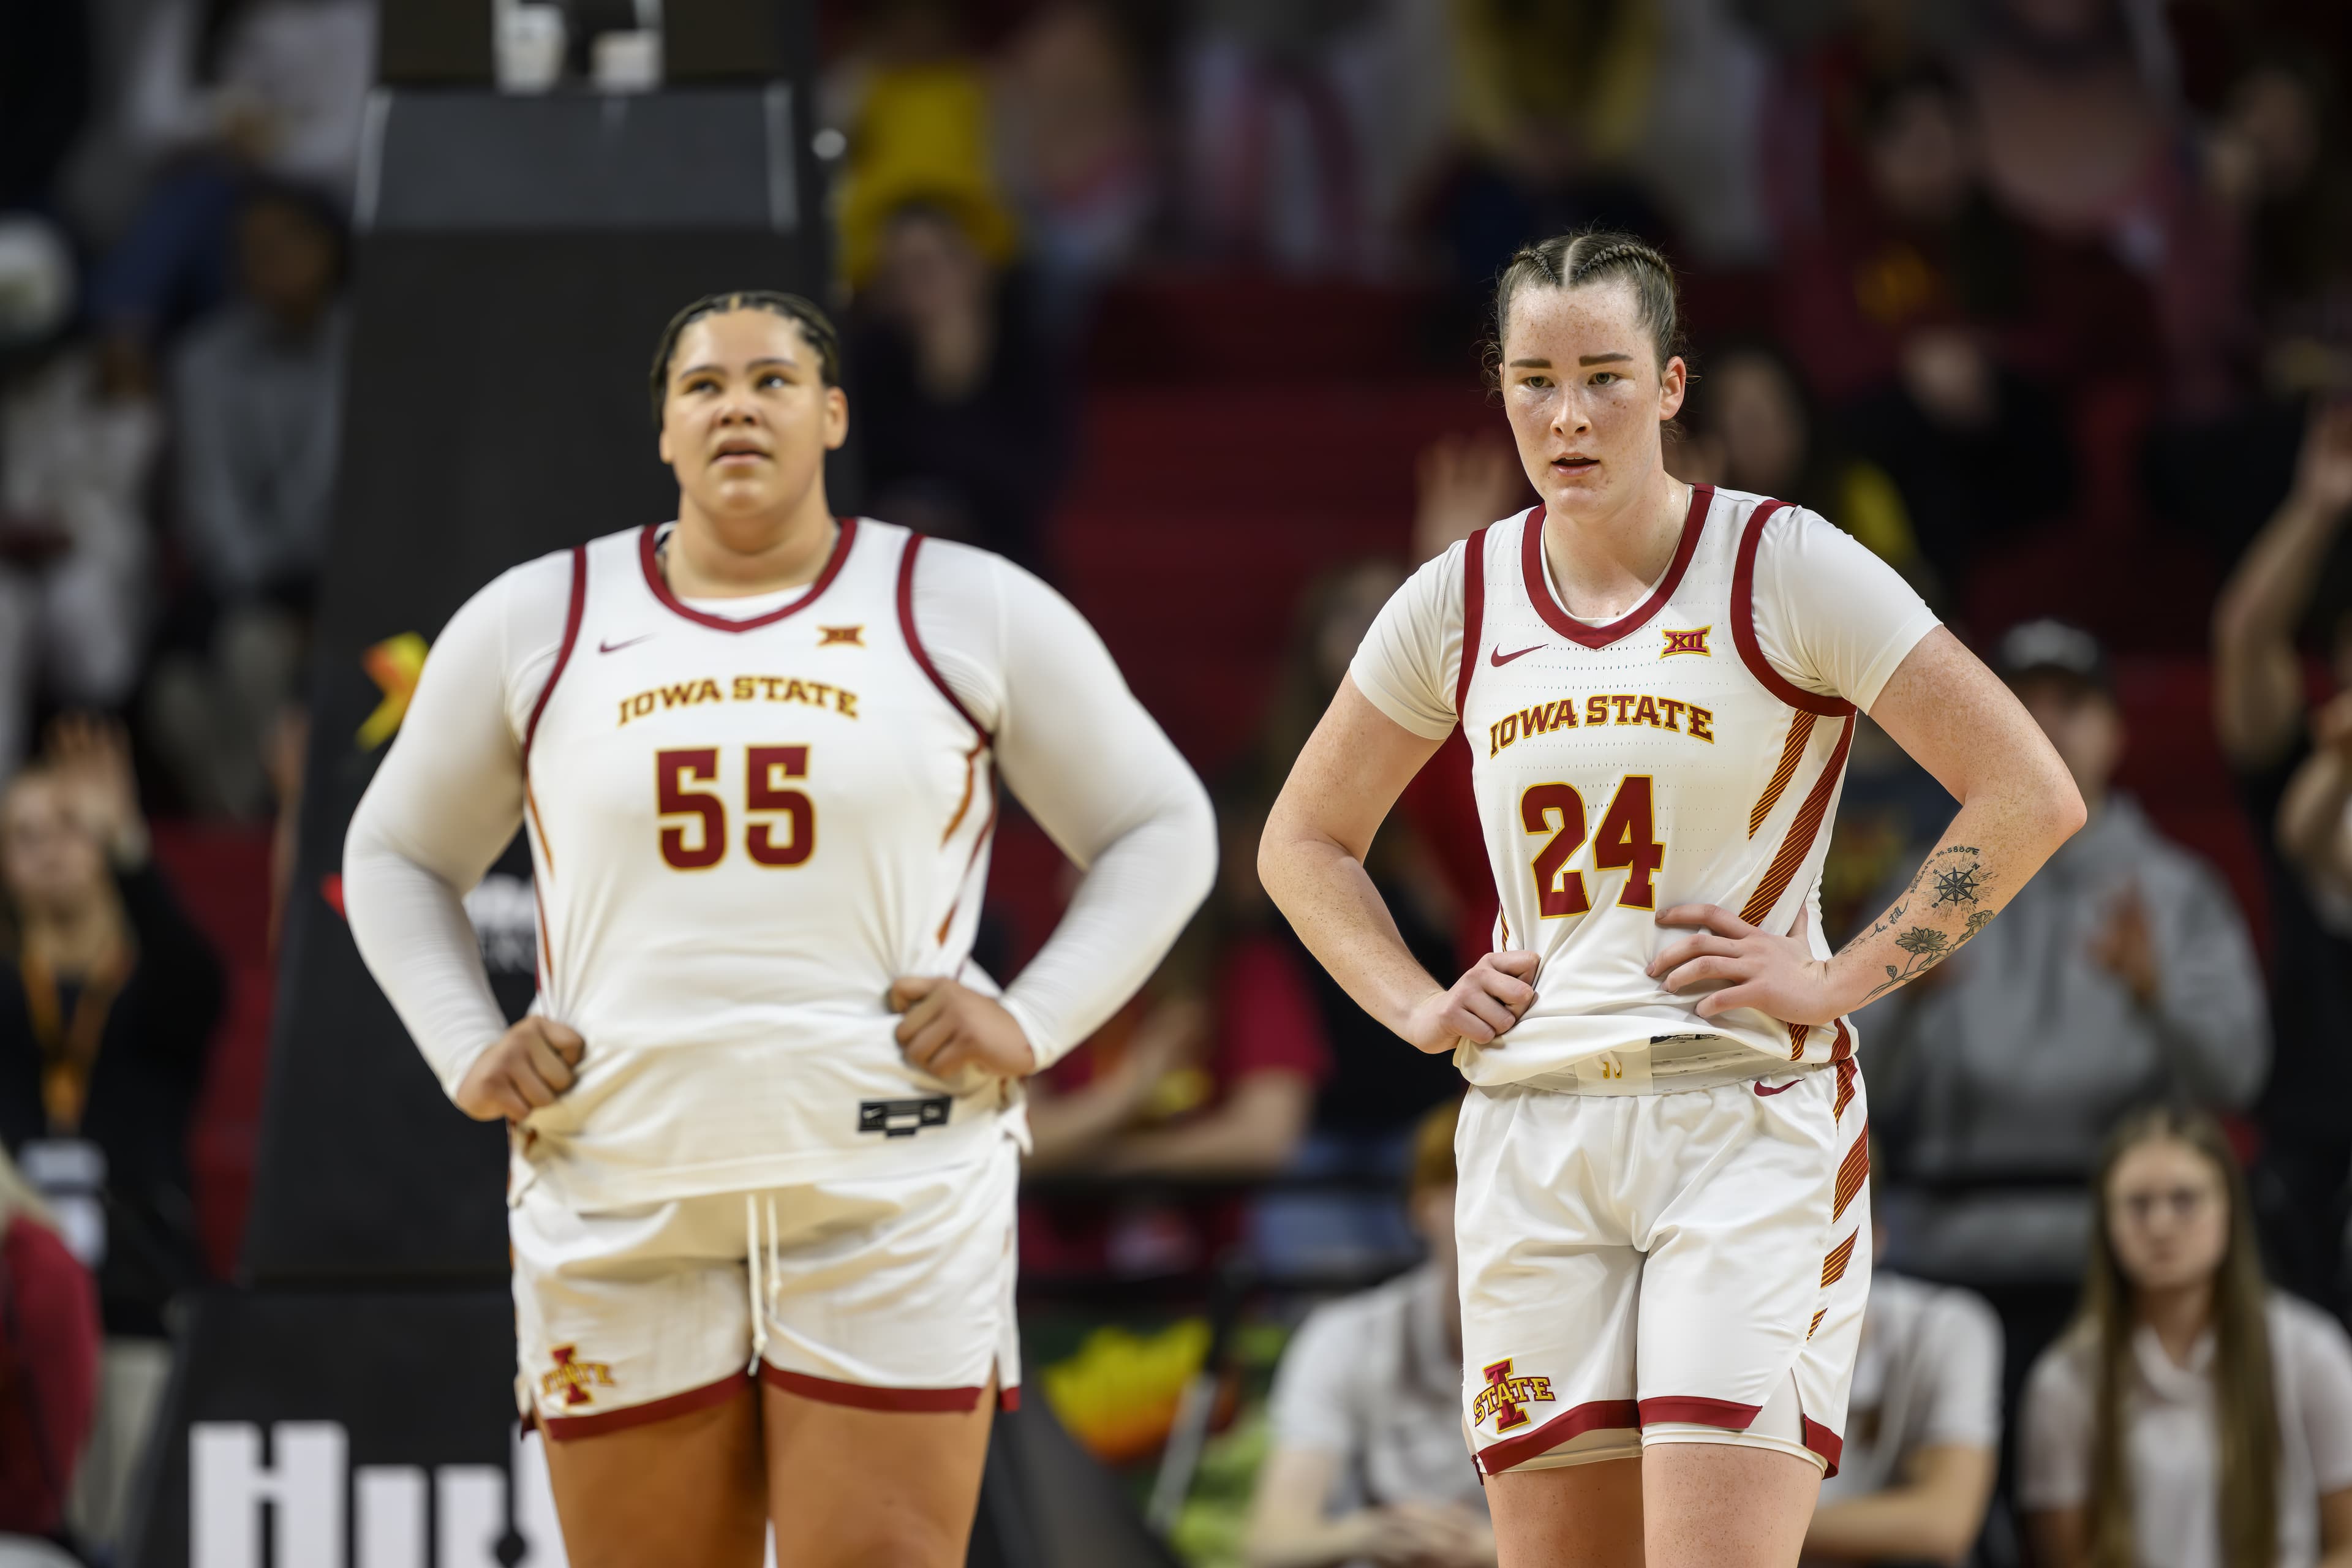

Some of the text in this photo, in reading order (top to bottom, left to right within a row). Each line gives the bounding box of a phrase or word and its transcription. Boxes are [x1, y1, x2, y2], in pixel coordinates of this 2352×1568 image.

[1660, 625, 1712, 658] XII
[618, 675, 859, 727] IOWA STATE
[1490, 694, 1714, 760] IOWA STATE
[654, 744, 818, 873] 55
[1520, 774, 1666, 919] 24
[1472, 1376, 1556, 1427] STATE
